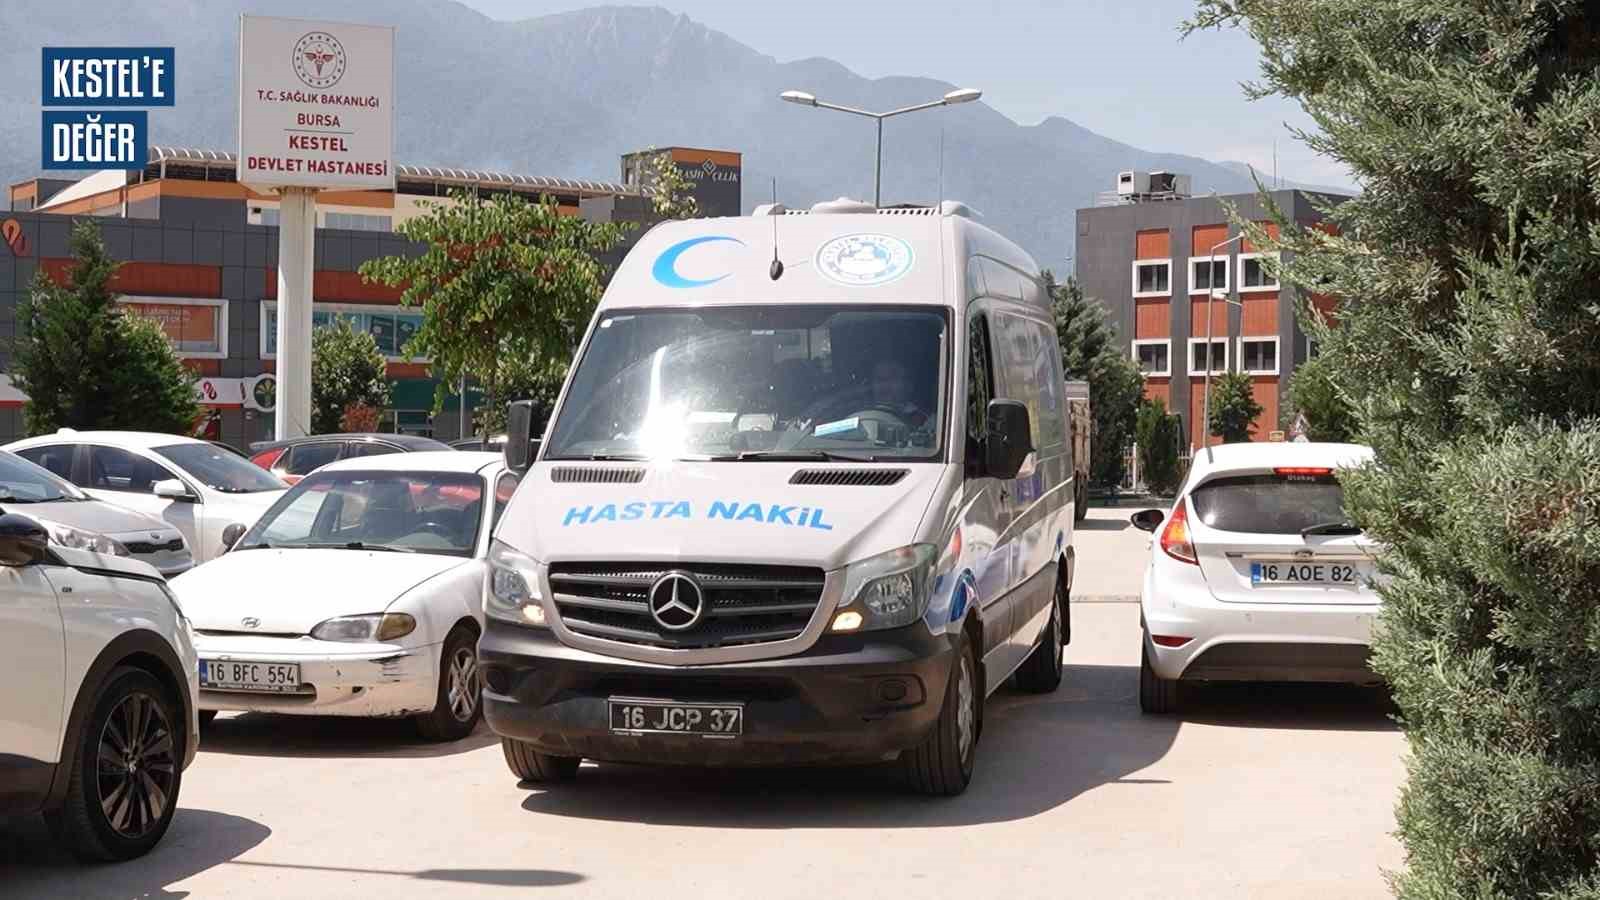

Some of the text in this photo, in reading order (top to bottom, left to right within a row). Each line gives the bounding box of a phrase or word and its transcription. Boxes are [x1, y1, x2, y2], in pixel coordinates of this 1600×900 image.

[257, 90, 380, 108] T.C. SAĞLIK BAKANLIĞI
[297, 113, 341, 127] BURSA
[289, 136, 348, 152] KESTEL
[248, 157, 387, 176] DEVLET HASTANESİ
[563, 501, 691, 526] HASTA
[1262, 565, 1353, 582] 16 AOE 82
[210, 663, 294, 684] 16 BFC 554
[622, 706, 739, 732] 16 JCP 37
